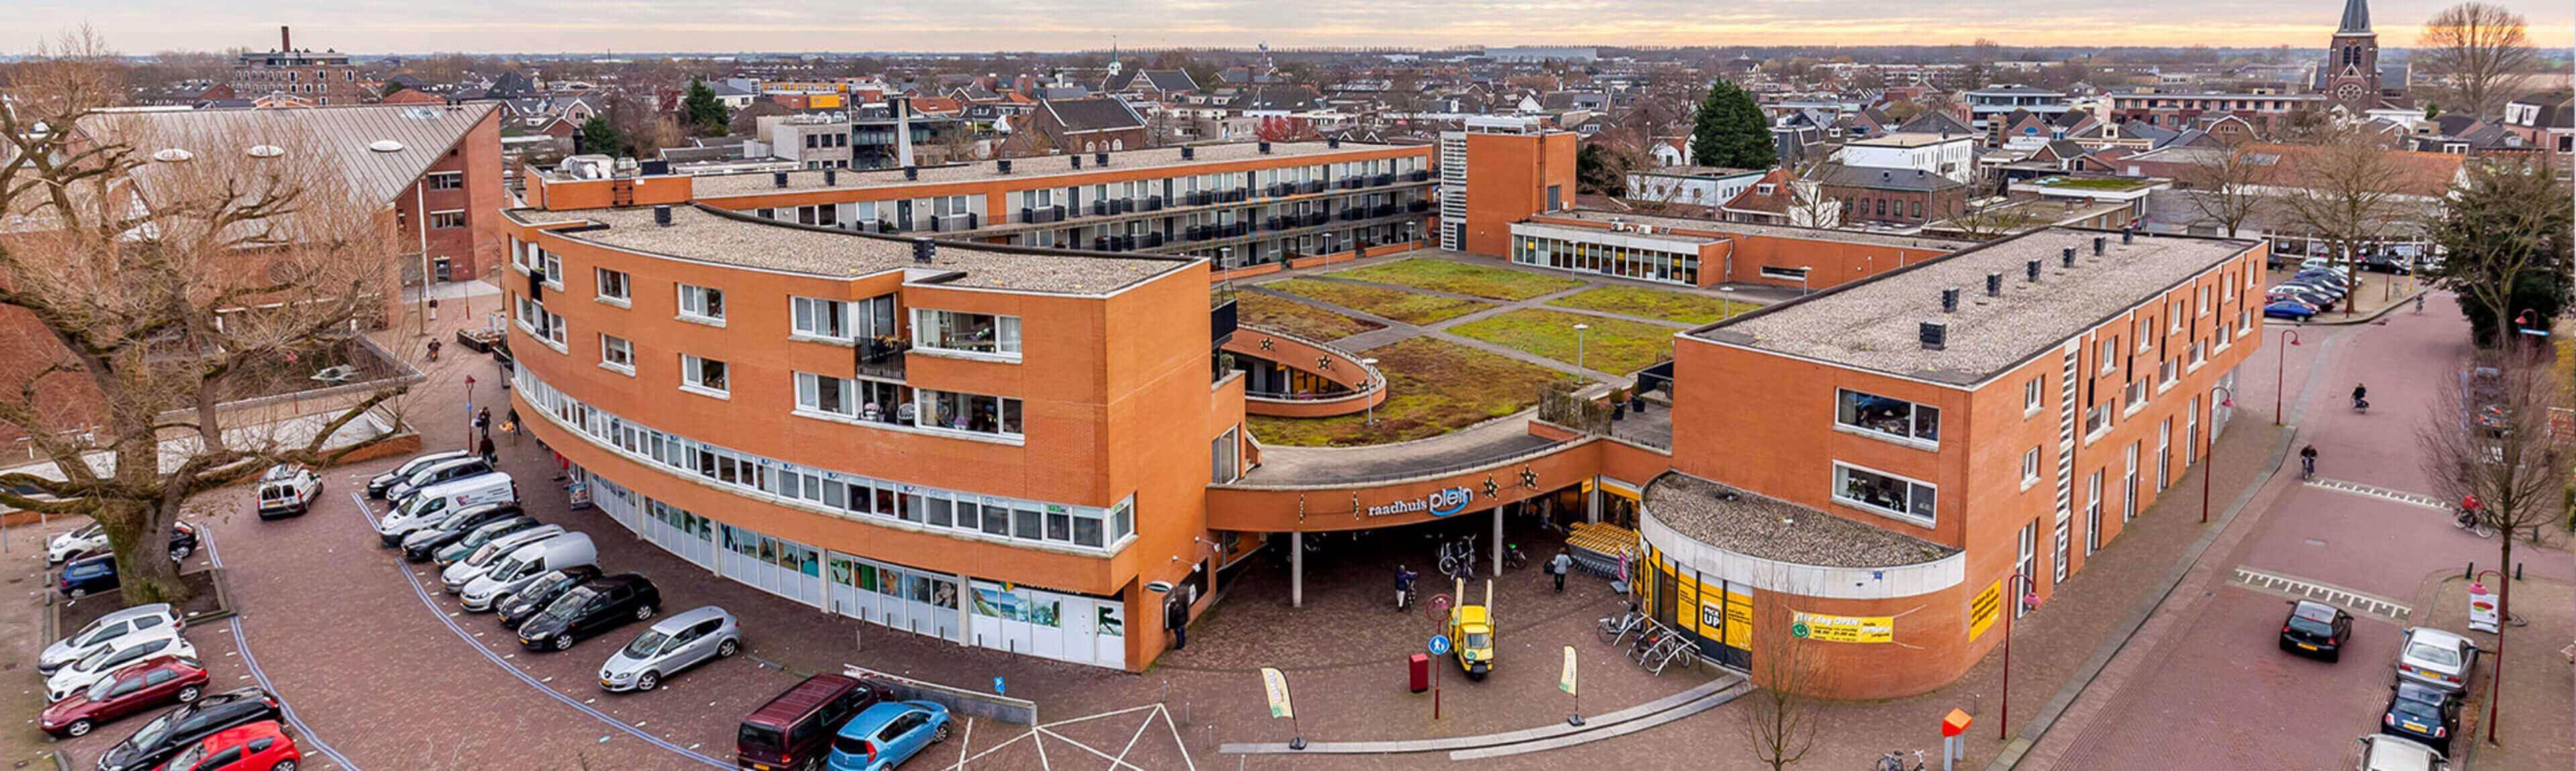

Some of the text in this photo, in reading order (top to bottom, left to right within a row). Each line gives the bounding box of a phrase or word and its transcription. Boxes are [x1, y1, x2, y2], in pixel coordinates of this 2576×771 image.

[1368, 485, 1474, 516] raadhuis plein
[1704, 613, 1720, 627] UP
